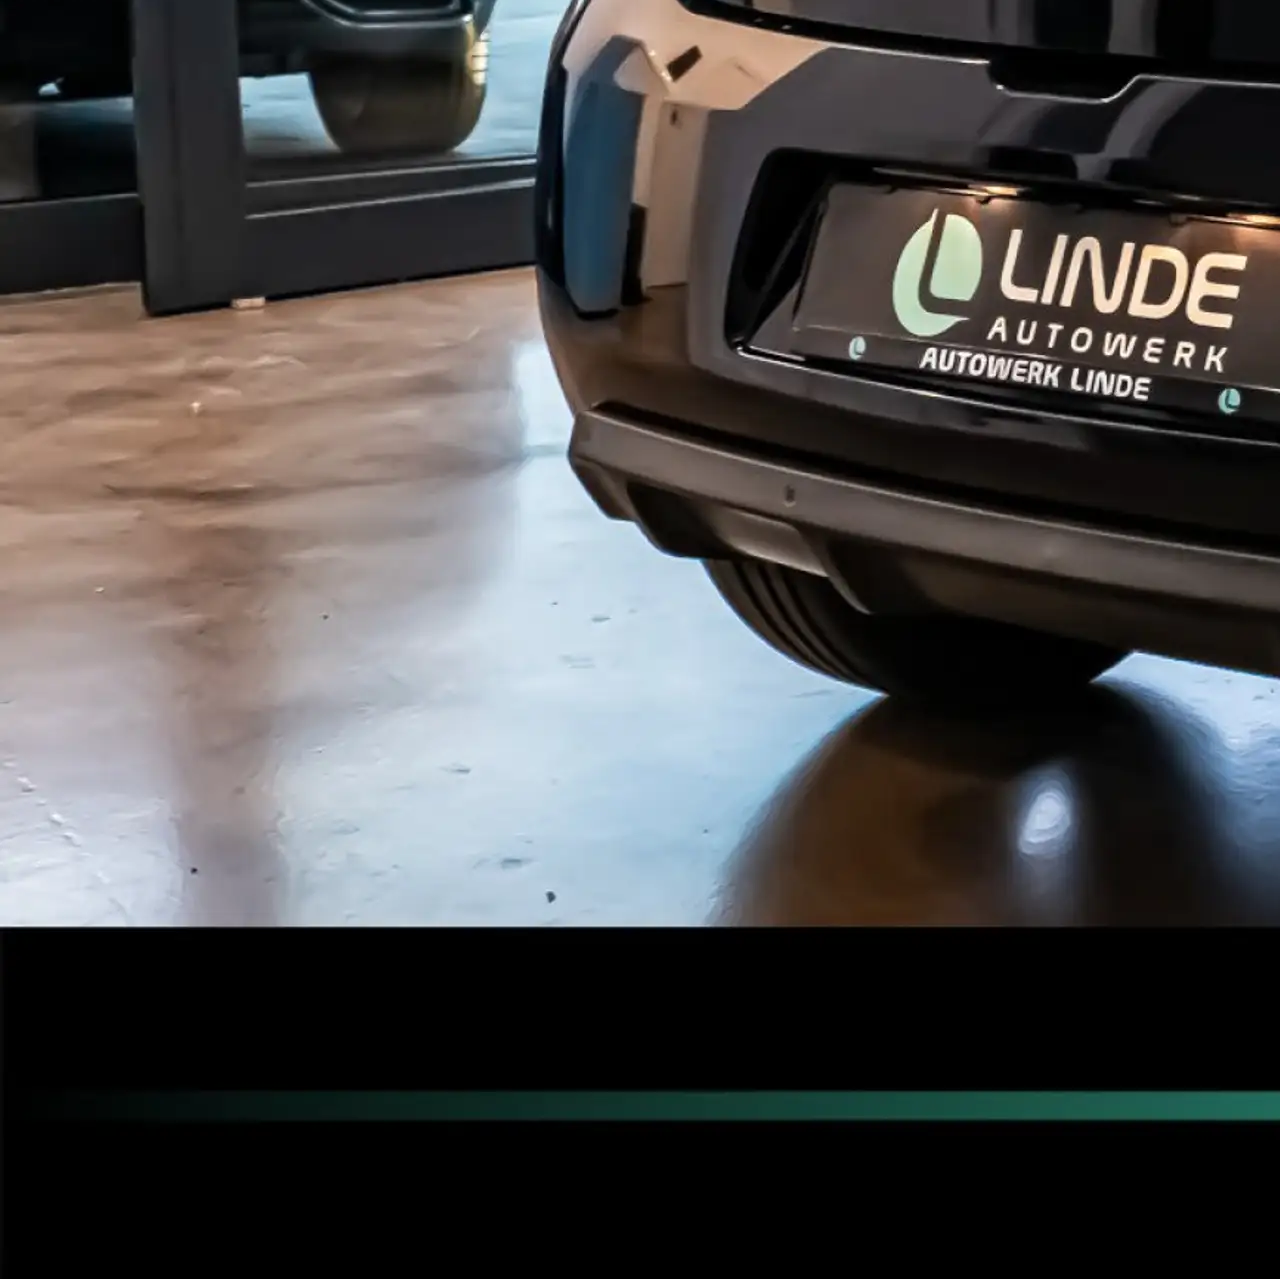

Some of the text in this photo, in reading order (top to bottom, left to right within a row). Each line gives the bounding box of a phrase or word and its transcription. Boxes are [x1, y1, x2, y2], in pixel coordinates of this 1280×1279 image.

[1000, 228, 1249, 329] LINDE
[986, 316, 1228, 373] AUTOWERK
[918, 346, 1152, 401] AUTOWERK LINDE
